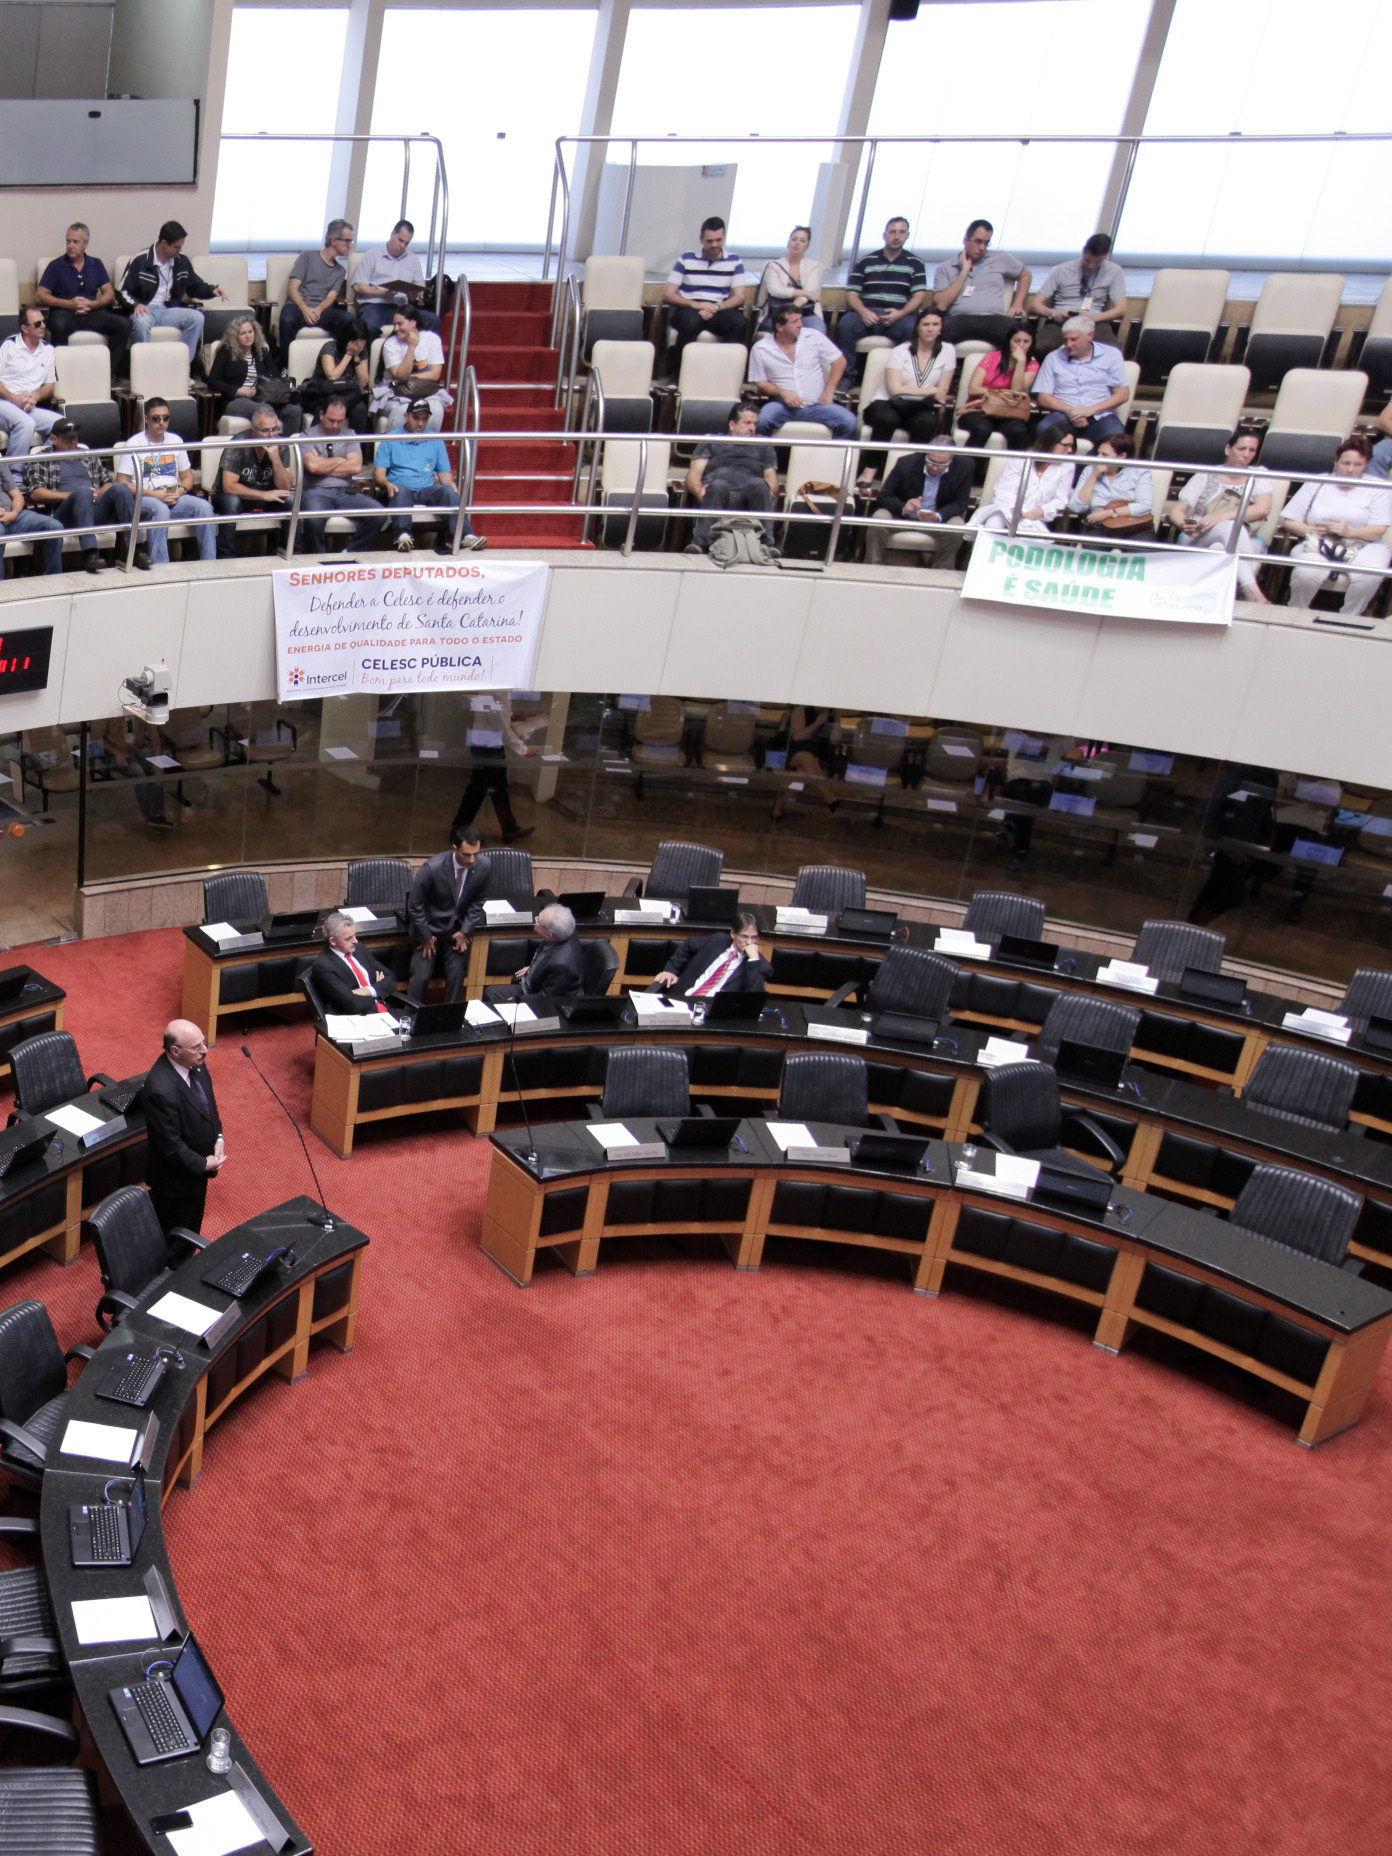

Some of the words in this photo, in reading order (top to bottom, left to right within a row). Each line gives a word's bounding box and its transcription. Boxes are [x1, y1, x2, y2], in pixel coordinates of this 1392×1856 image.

[988, 541, 1146, 581] PODOLOGIA
[289, 568, 376, 587] SENHORES
[381, 565, 485, 580] DEPUTADOS,
[310, 592, 368, 615] Defender
[369, 599, 379, 607] a
[383, 588, 426, 608] Celesc
[427, 591, 436, 606] é
[437, 588, 499, 610] defender
[499, 594, 505, 604] o
[1002, 573, 1018, 597] É
[1023, 579, 1116, 609] SAÚDE
[289, 614, 393, 638] desenvolvimento
[397, 614, 412, 629] de
[414, 612, 455, 630] Santa
[459, 610, 524, 629] Catarina!
[287, 644, 331, 654] ENERGIA
[335, 642, 347, 650] DE
[350, 638, 407, 649] QUALIDADE
[410, 637, 436, 646] PARA
[440, 637, 468, 645] TODO
[472, 636, 480, 644] O
[483, 635, 522, 644] ESTADO
[361, 657, 417, 670] CELESC
[421, 654, 482, 668] PÚBLICA
[307, 671, 347, 685] Intercel
[361, 673, 385, 685] Bom
[388, 675, 415, 689] para
[416, 670, 439, 683] todo
[442, 669, 485, 682] mundo!
